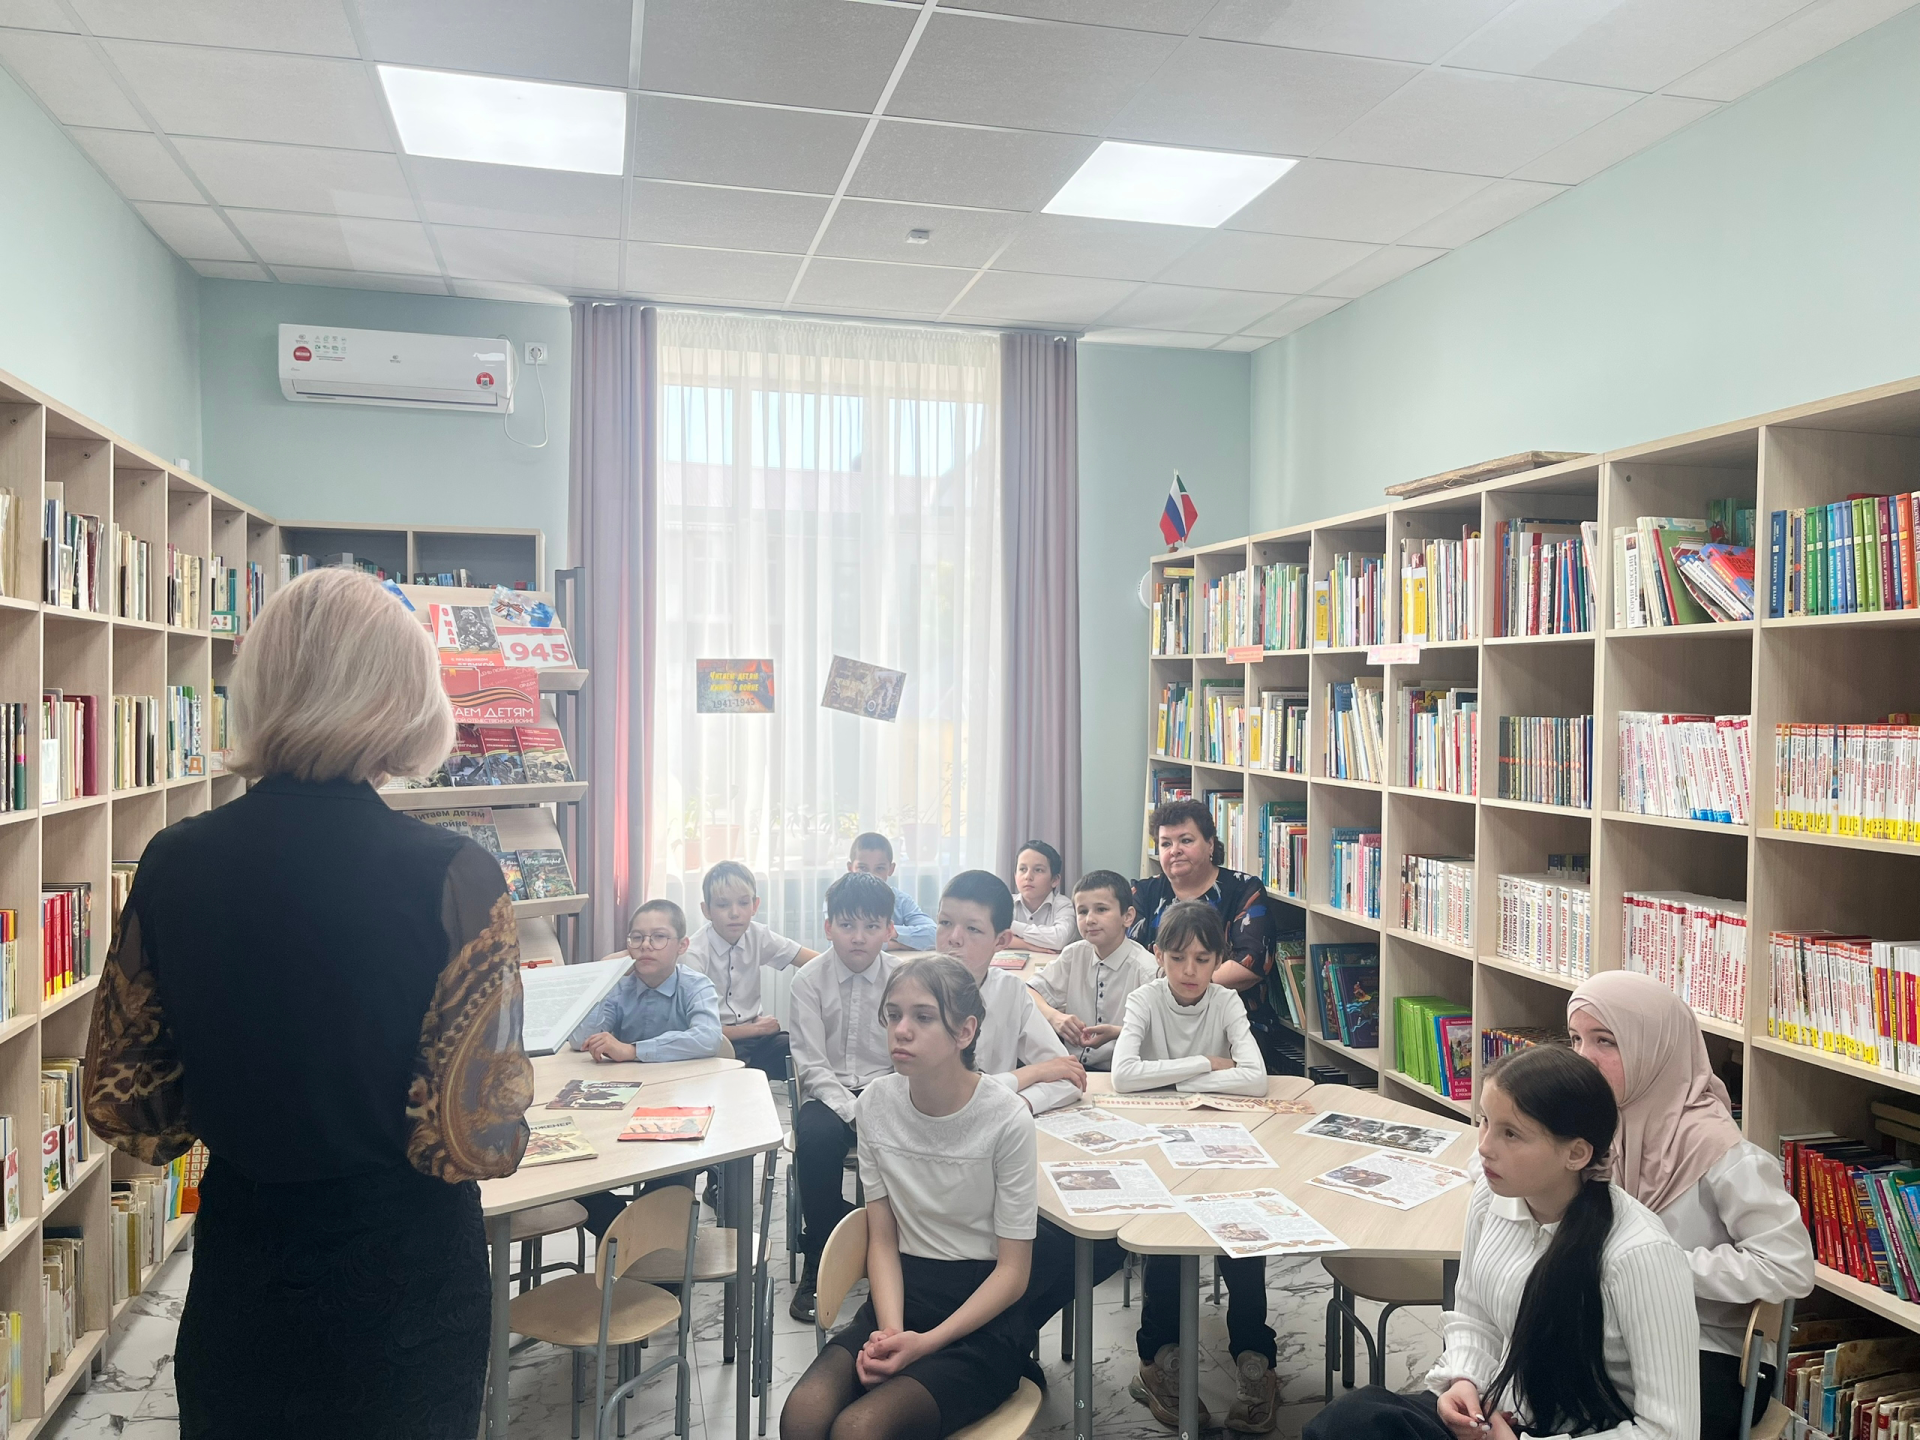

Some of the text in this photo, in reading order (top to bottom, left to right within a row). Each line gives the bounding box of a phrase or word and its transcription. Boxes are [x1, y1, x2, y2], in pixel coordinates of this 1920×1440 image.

[441, 608, 449, 616] 9
[712, 698, 755, 709] 1941-1945
[453, 707, 534, 718] АЕМ ДЕТЯМ
[188, 757, 202, 773] Д
[453, 809, 485, 820] детям
[43, 1130, 58, 1155] З
[6, 1149, 17, 1180] Ж
[1825, 1174, 1834, 1198] ВВЕРХ!
